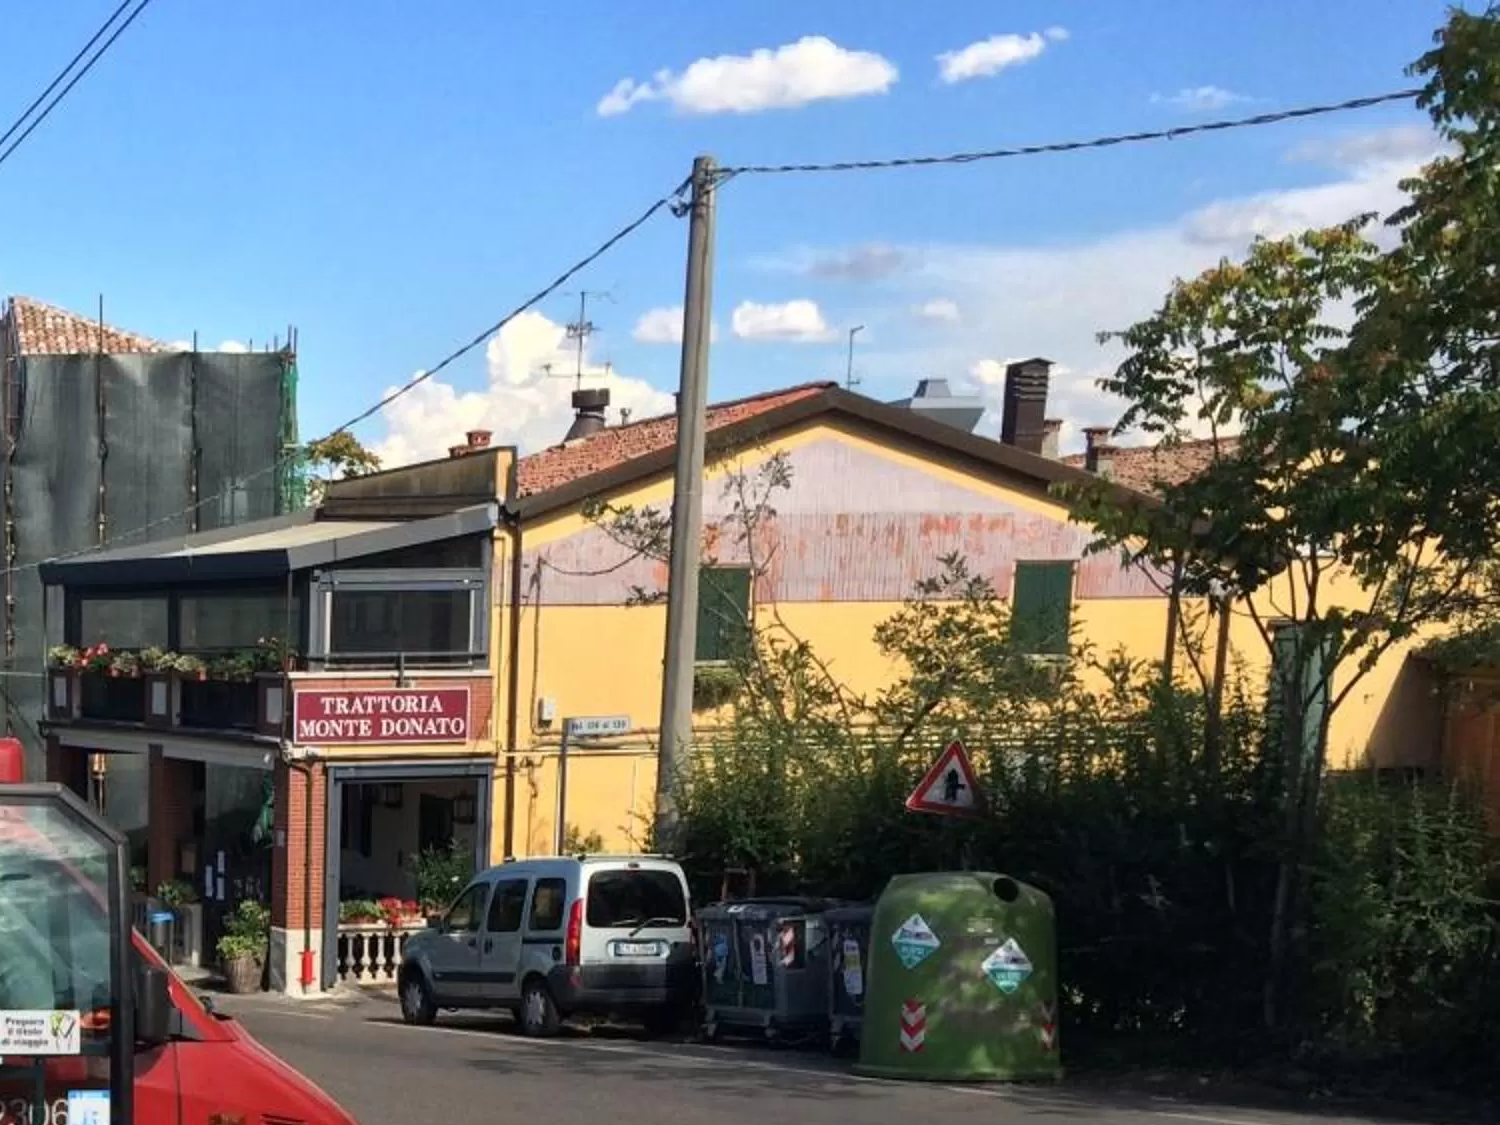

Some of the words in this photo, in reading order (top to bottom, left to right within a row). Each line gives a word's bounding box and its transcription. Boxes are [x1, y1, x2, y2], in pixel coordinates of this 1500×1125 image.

[320, 695, 443, 715] TRATTORIA
[299, 719, 372, 738] MONTE
[379, 717, 465, 737] DONATO
